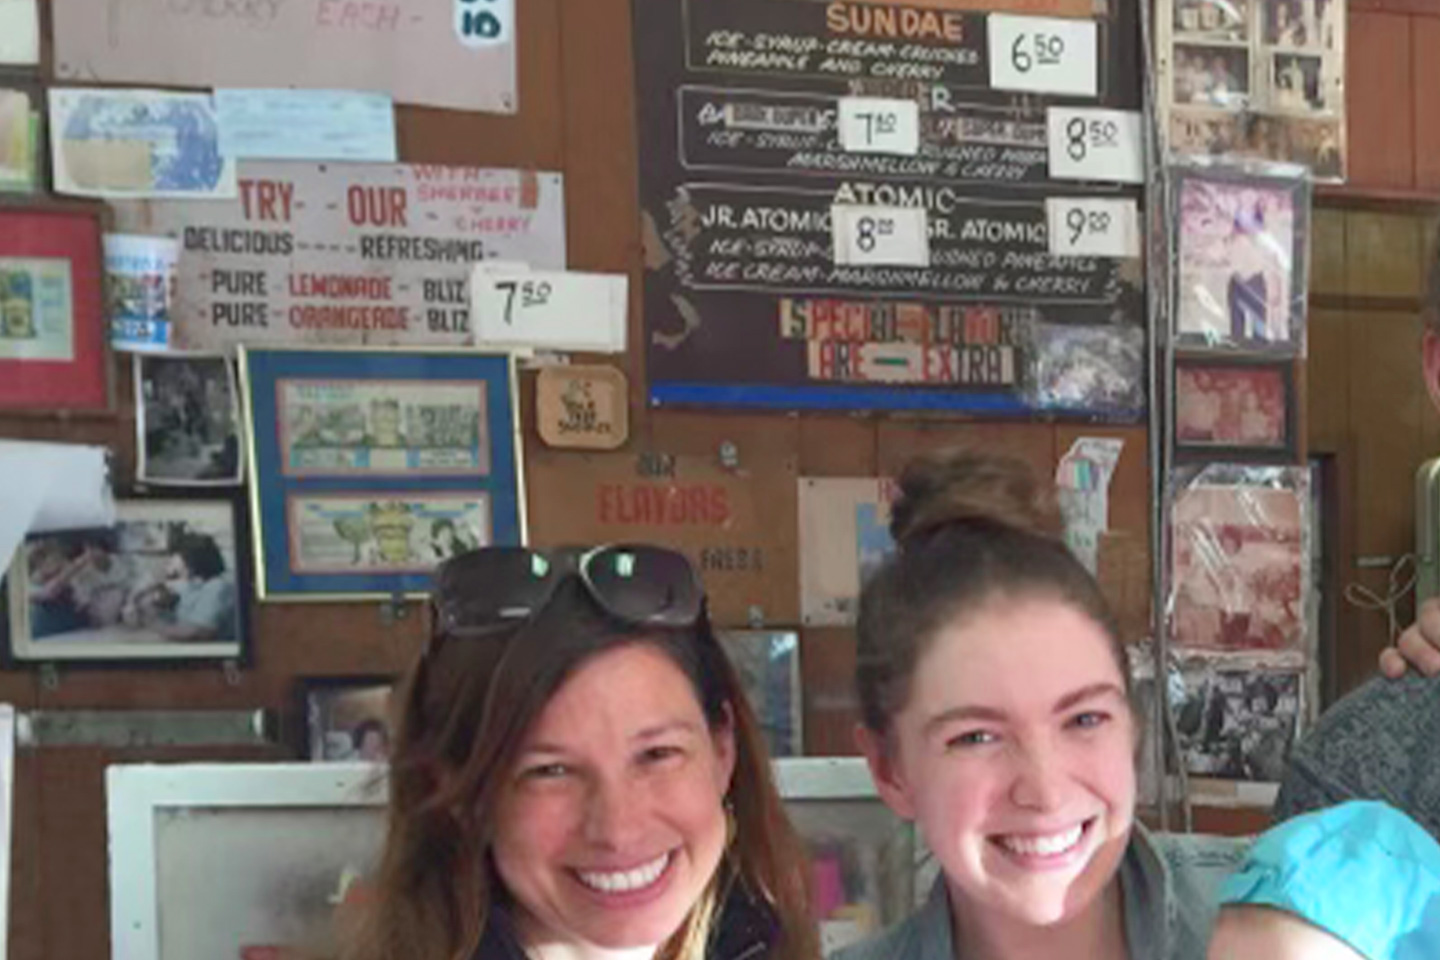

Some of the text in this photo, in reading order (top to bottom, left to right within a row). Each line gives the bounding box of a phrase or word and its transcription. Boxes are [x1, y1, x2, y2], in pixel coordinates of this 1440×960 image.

[826, 2, 964, 41] SUNDAE
[238, 178, 408, 228] TRY OUR
[833, 181, 956, 213] ATOMIC
[740, 207, 832, 231] ATOMIC
[960, 219, 1047, 243] ATOMIC
[184, 227, 484, 263] DELICIOUS REFRESHING
[212, 270, 267, 296] PURE
[289, 273, 392, 300] LEMONADE
[212, 302, 269, 328] PURE
[289, 305, 410, 331] ORANGEADE
[923, 346, 1003, 384] EXTRA
